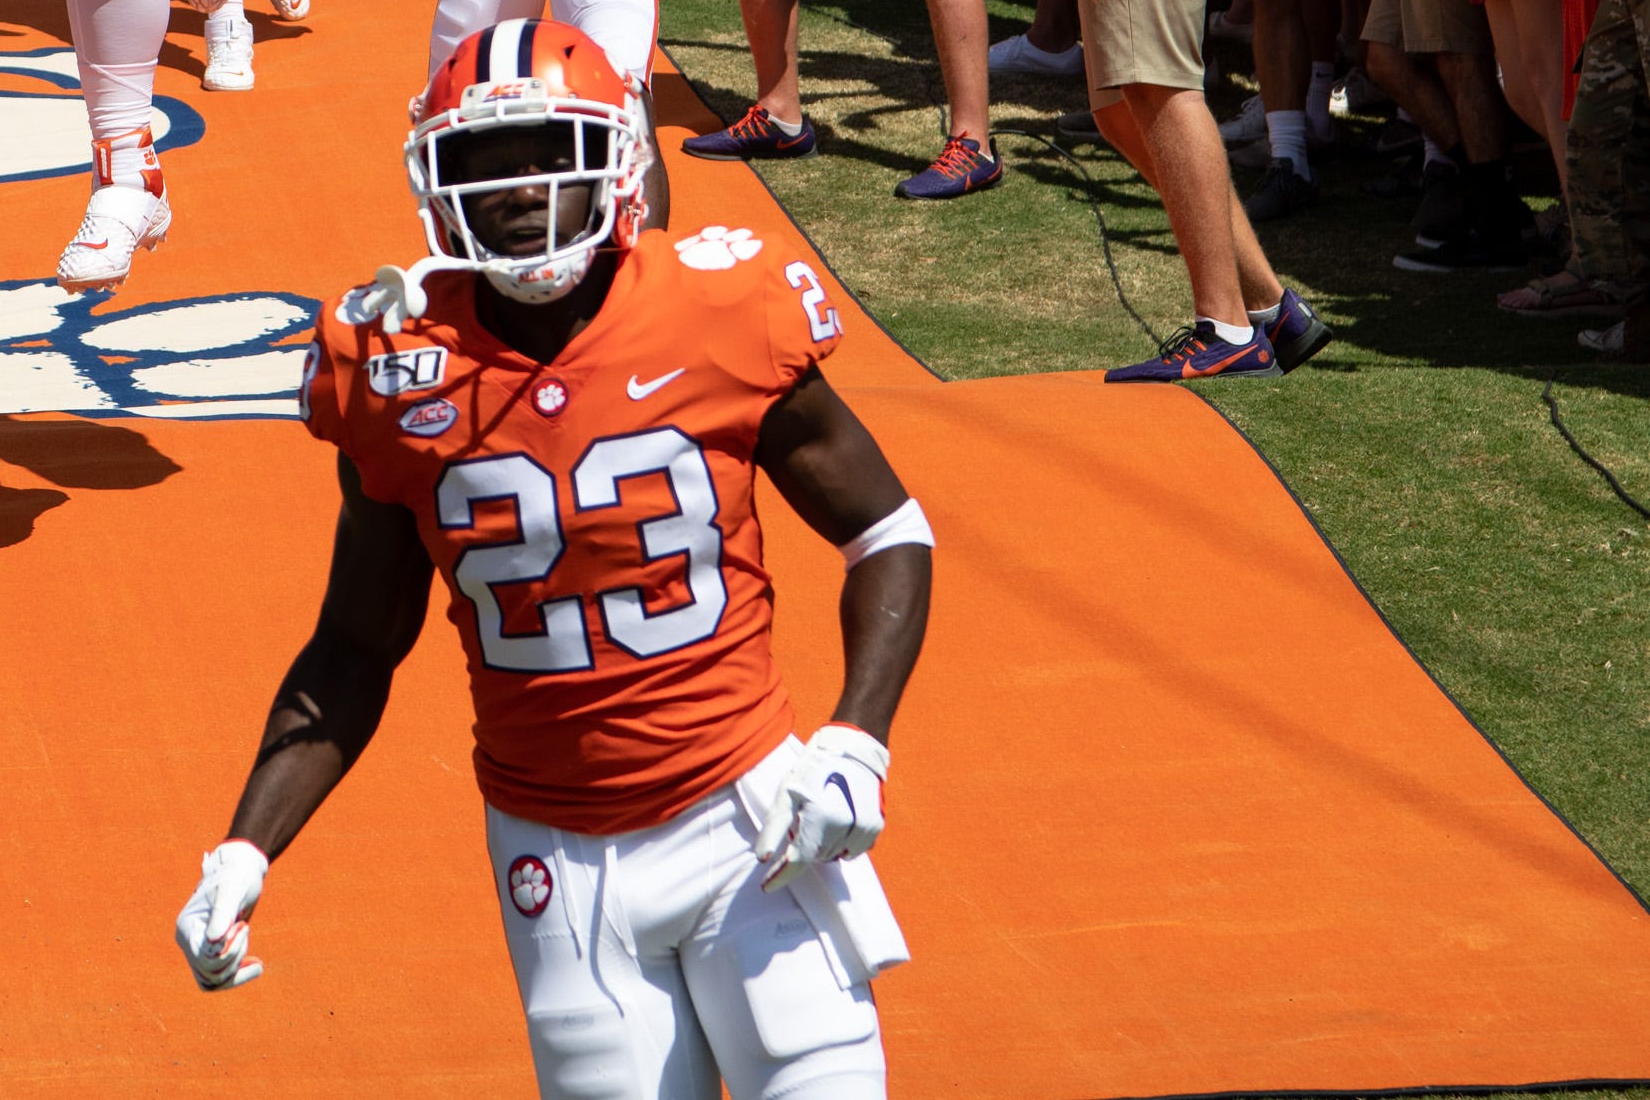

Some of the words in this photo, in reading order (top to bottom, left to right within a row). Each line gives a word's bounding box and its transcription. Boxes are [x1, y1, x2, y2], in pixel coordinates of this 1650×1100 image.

[370, 348, 446, 390] 150
[408, 405, 450, 427] ACC
[434, 424, 729, 674] 23
